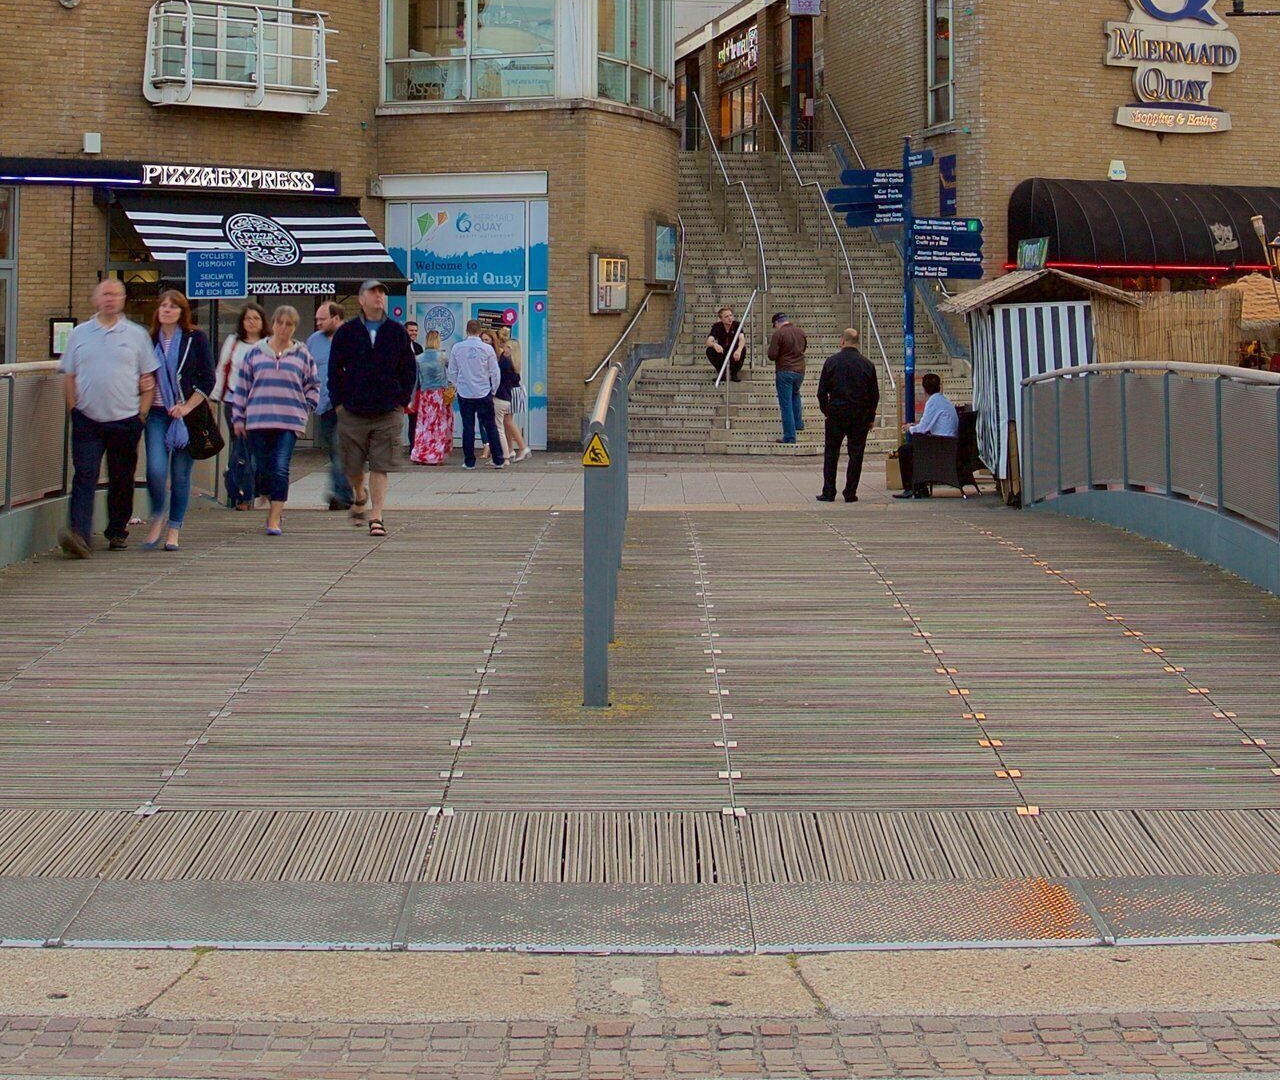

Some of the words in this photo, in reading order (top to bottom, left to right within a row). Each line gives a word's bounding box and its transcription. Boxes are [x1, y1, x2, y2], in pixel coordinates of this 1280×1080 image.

[1110, 27, 1238, 67] MERMAID
[1142, 67, 1210, 103] QUAY
[1130, 110, 1175, 128] Shopping
[1176, 113, 1186, 126] &
[1186, 113, 1219, 130] Eating
[473, 222, 503, 233] QUAY
[199, 252, 234, 260] CYCLISTS
[197, 260, 236, 268] DISMOUNT
[414, 260, 463, 271] Welcome
[466, 261, 478, 270] to
[413, 272, 479, 285] Mermaid
[482, 272, 522, 288] Quay
[280, 282, 336, 295] EXPRESS
